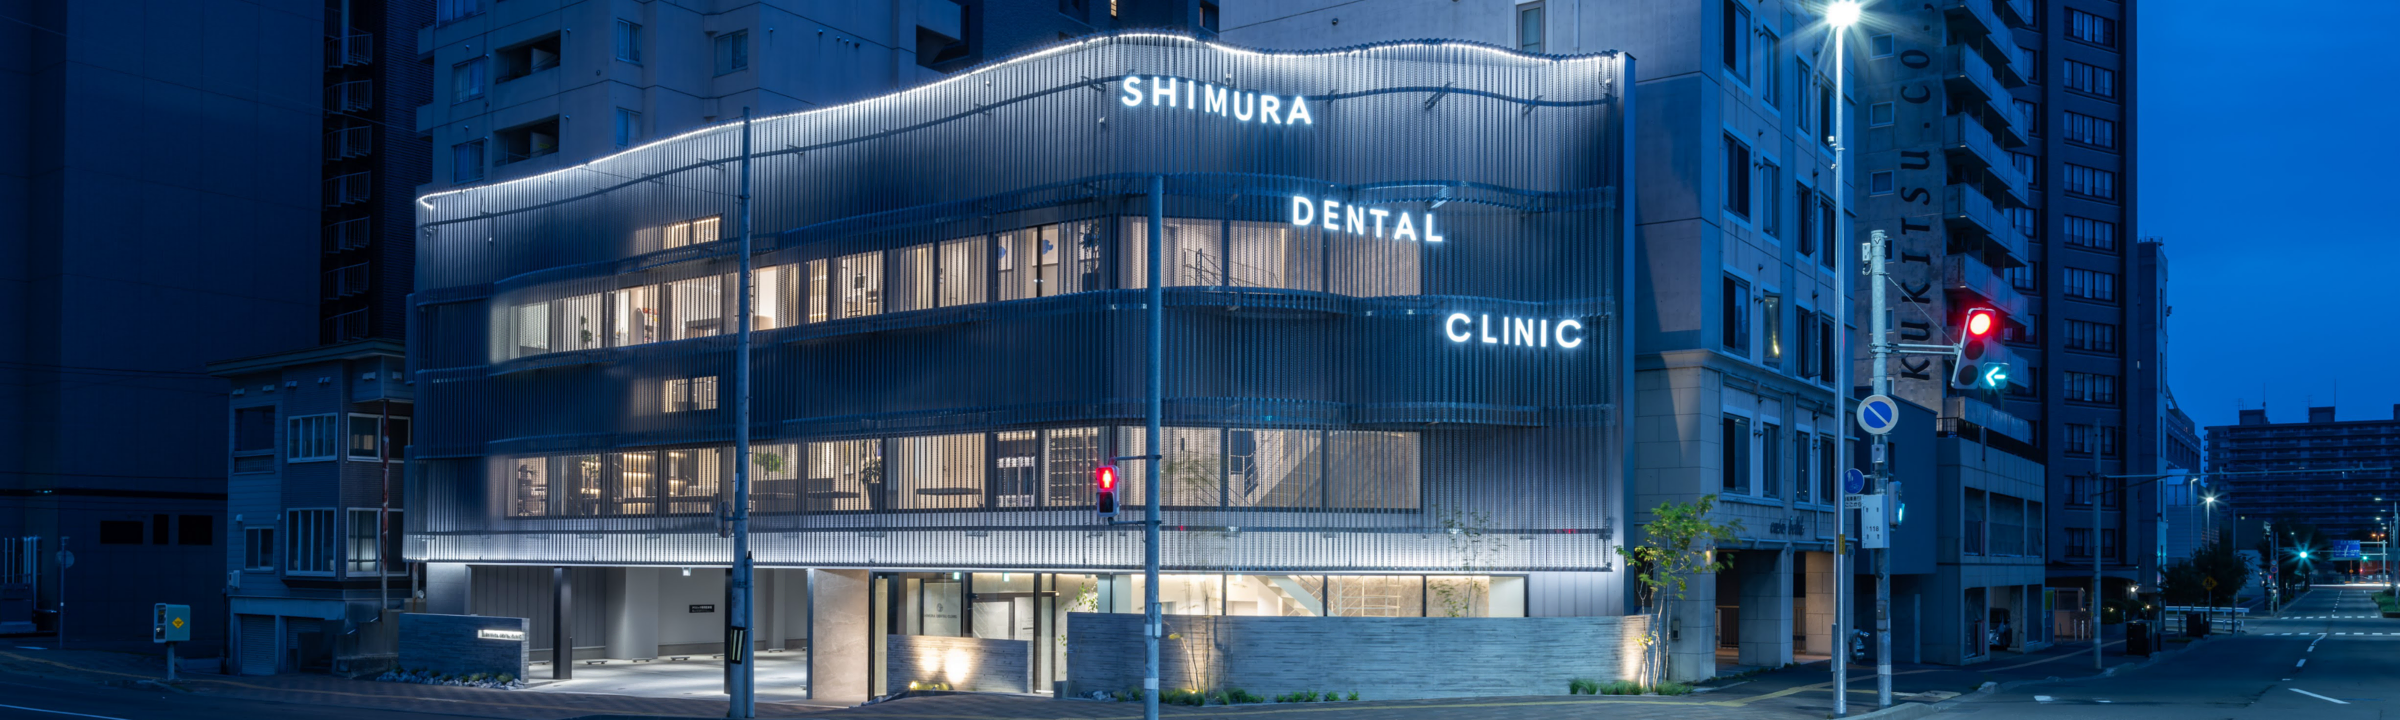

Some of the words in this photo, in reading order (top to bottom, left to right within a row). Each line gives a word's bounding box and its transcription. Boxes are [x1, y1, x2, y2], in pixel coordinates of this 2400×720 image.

[1121, 76, 1312, 125] SHIMURA
[1293, 196, 1443, 242] DENTAL
[1446, 312, 1582, 348] CLINIC
